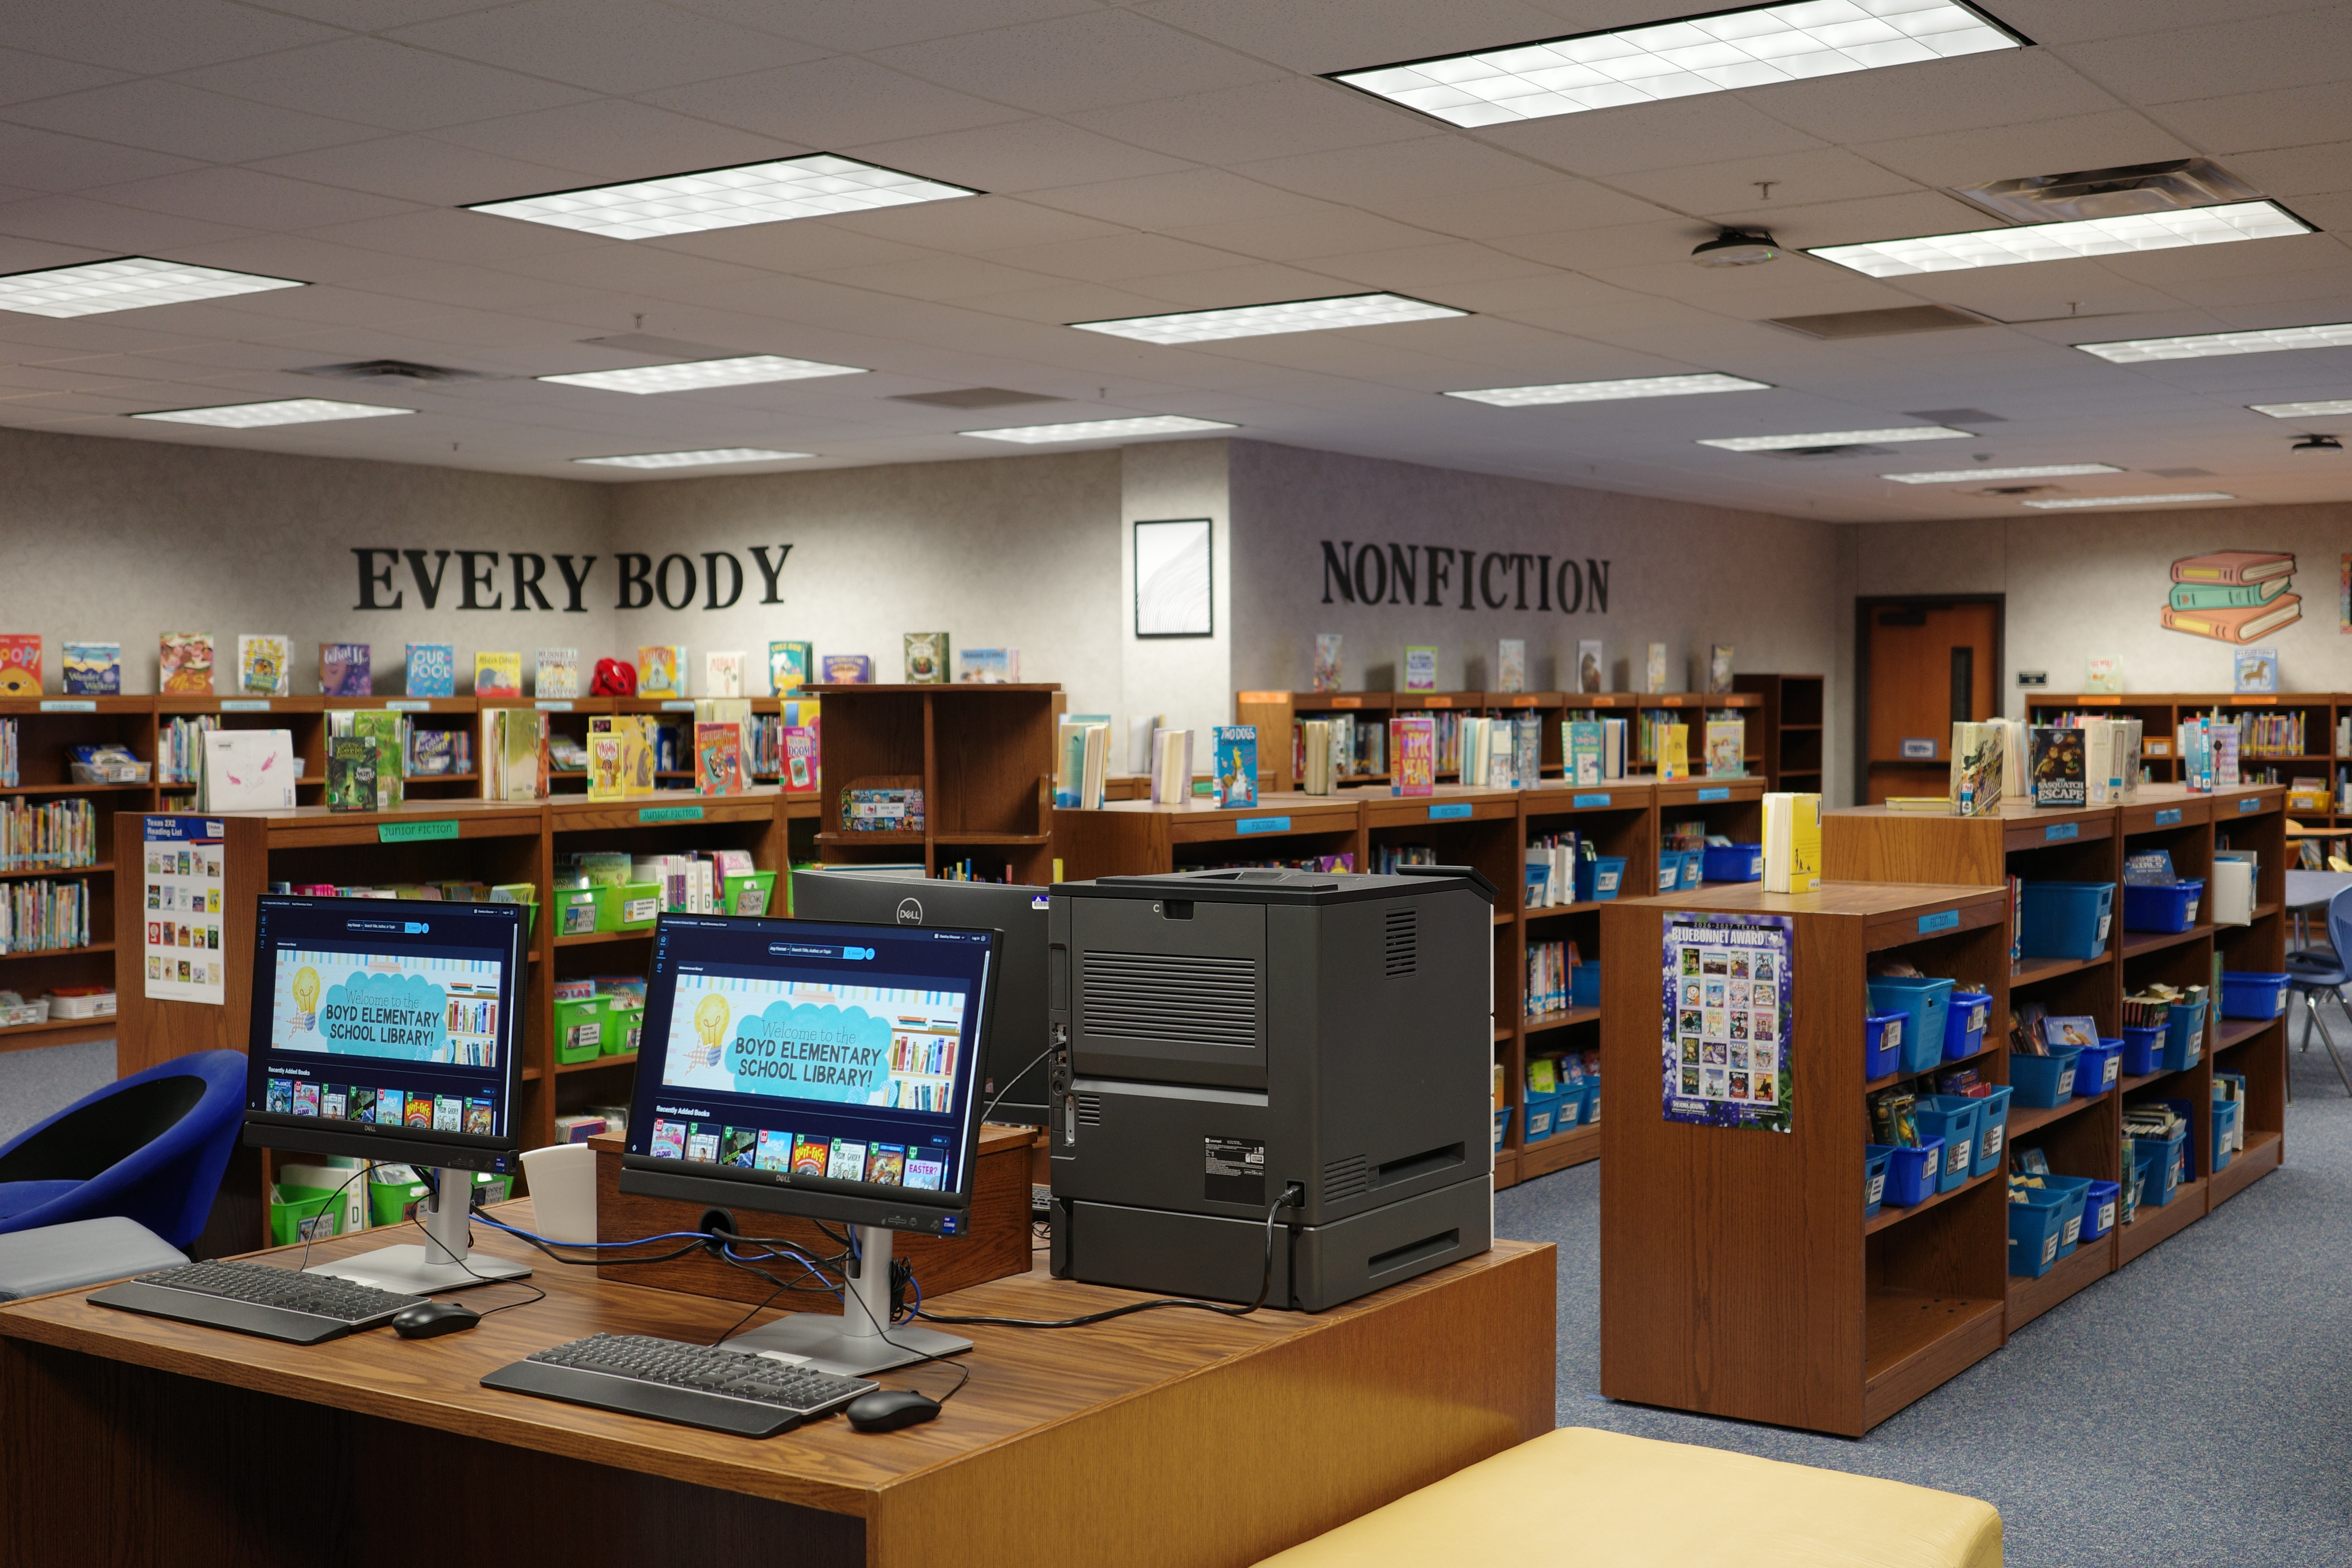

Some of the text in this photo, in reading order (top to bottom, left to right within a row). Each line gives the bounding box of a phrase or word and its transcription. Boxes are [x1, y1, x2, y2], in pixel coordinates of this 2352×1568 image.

[351, 544, 792, 612] EVERY BODY
[1321, 540, 1611, 615] NONFICTION
[0, 646, 40, 669] OOP!
[414, 650, 445, 664] OUR
[411, 664, 450, 678] POOL
[701, 729, 727, 741] GEEGER
[1221, 727, 1256, 740] TWO DOGS
[598, 741, 617, 757] YASMIN
[788, 746, 811, 756] DOOM
[1408, 732, 1430, 758] EPIC
[1402, 759, 1431, 785] YEAR
[2037, 782, 2084, 790] SASQUATCH
[2038, 789, 2084, 800] ESCAPE
[643, 808, 699, 819] JUNIOR FICTION
[147, 818, 176, 827] Texas 2X2
[147, 827, 182, 837] Reading List
[384, 825, 452, 837] JUNIOR FICTION
[2129, 855, 2163, 863] GAMER
[691, 895, 695, 910] F
[705, 894, 710, 908] G
[749, 895, 762, 903] OWL
[900, 910, 920, 920] DELL
[1153, 904, 1160, 913] C
[1930, 915, 1949, 928] FICTION
[1672, 928, 1764, 946] BLUEBONNET AWARD
[345, 989, 419, 1009] Welcome to the
[571, 989, 591, 997] LAB
[326, 1004, 440, 1028] BOYD ELEMENTARY
[330, 1023, 434, 1047] SCHOOL LIBRARY!
[762, 1020, 856, 1044] Welcome to the
[735, 1037, 882, 1066] BOYD ELEMENTARY
[268, 1066, 284, 1075] Recently
[739, 1058, 873, 1088] SCHOOL LIBRARY!
[406, 1102, 431, 1117] BUTT FACE?
[448, 1106, 459, 1115] GARDEN
[656, 1105, 677, 1115] Recently
[694, 1109, 710, 1117] Books
[1673, 1101, 1706, 1110] PERMA-BOUND
[351, 1107, 364, 1119] BIGFOOT
[723, 1150, 741, 1164] BIGFOOT
[795, 1146, 825, 1164] BUTT FACE?
[834, 1151, 861, 1162] POISON GARDEN
[909, 1164, 938, 1176] EASTER?
[776, 1175, 790, 1183] DELL
[352, 1206, 359, 1223] D
